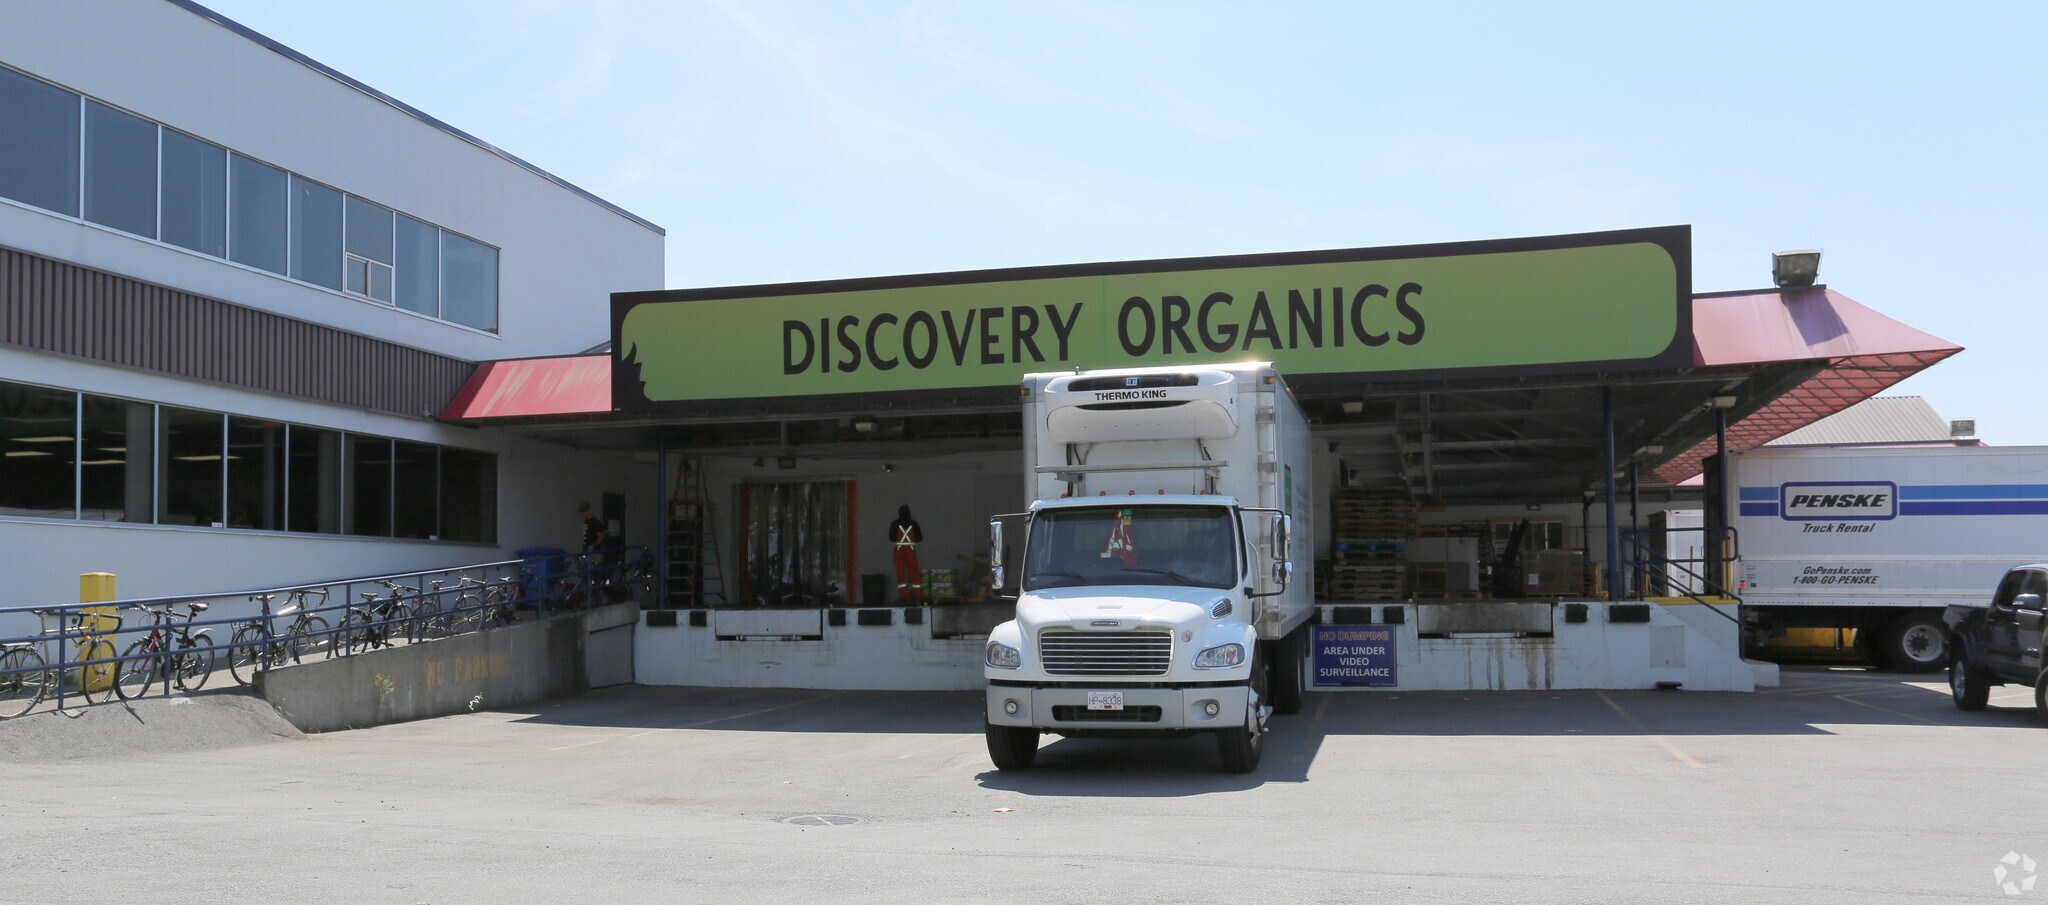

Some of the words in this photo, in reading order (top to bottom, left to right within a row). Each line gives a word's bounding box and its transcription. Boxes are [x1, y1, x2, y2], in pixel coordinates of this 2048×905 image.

[783, 302, 1083, 375] DISCOVERY
[1117, 282, 1425, 357] ORGANICS
[1095, 391, 1140, 401] THERMO
[1141, 389, 1167, 399] KING
[1789, 494, 1888, 508] PENSKE
[1802, 523, 1834, 533] Truck
[1836, 523, 1876, 533] Rental
[1803, 566, 1872, 575] GoPenske.com
[1793, 576, 1879, 585] 1-800-GO-PENSKE
[1319, 631, 1336, 641] NO
[1337, 631, 1390, 641] DUMPING
[1323, 646, 1349, 655] AREA
[1351, 646, 1386, 655] UNDER
[1339, 657, 1370, 666] VIDEO
[1320, 668, 1390, 677] SURVEILLANCE
